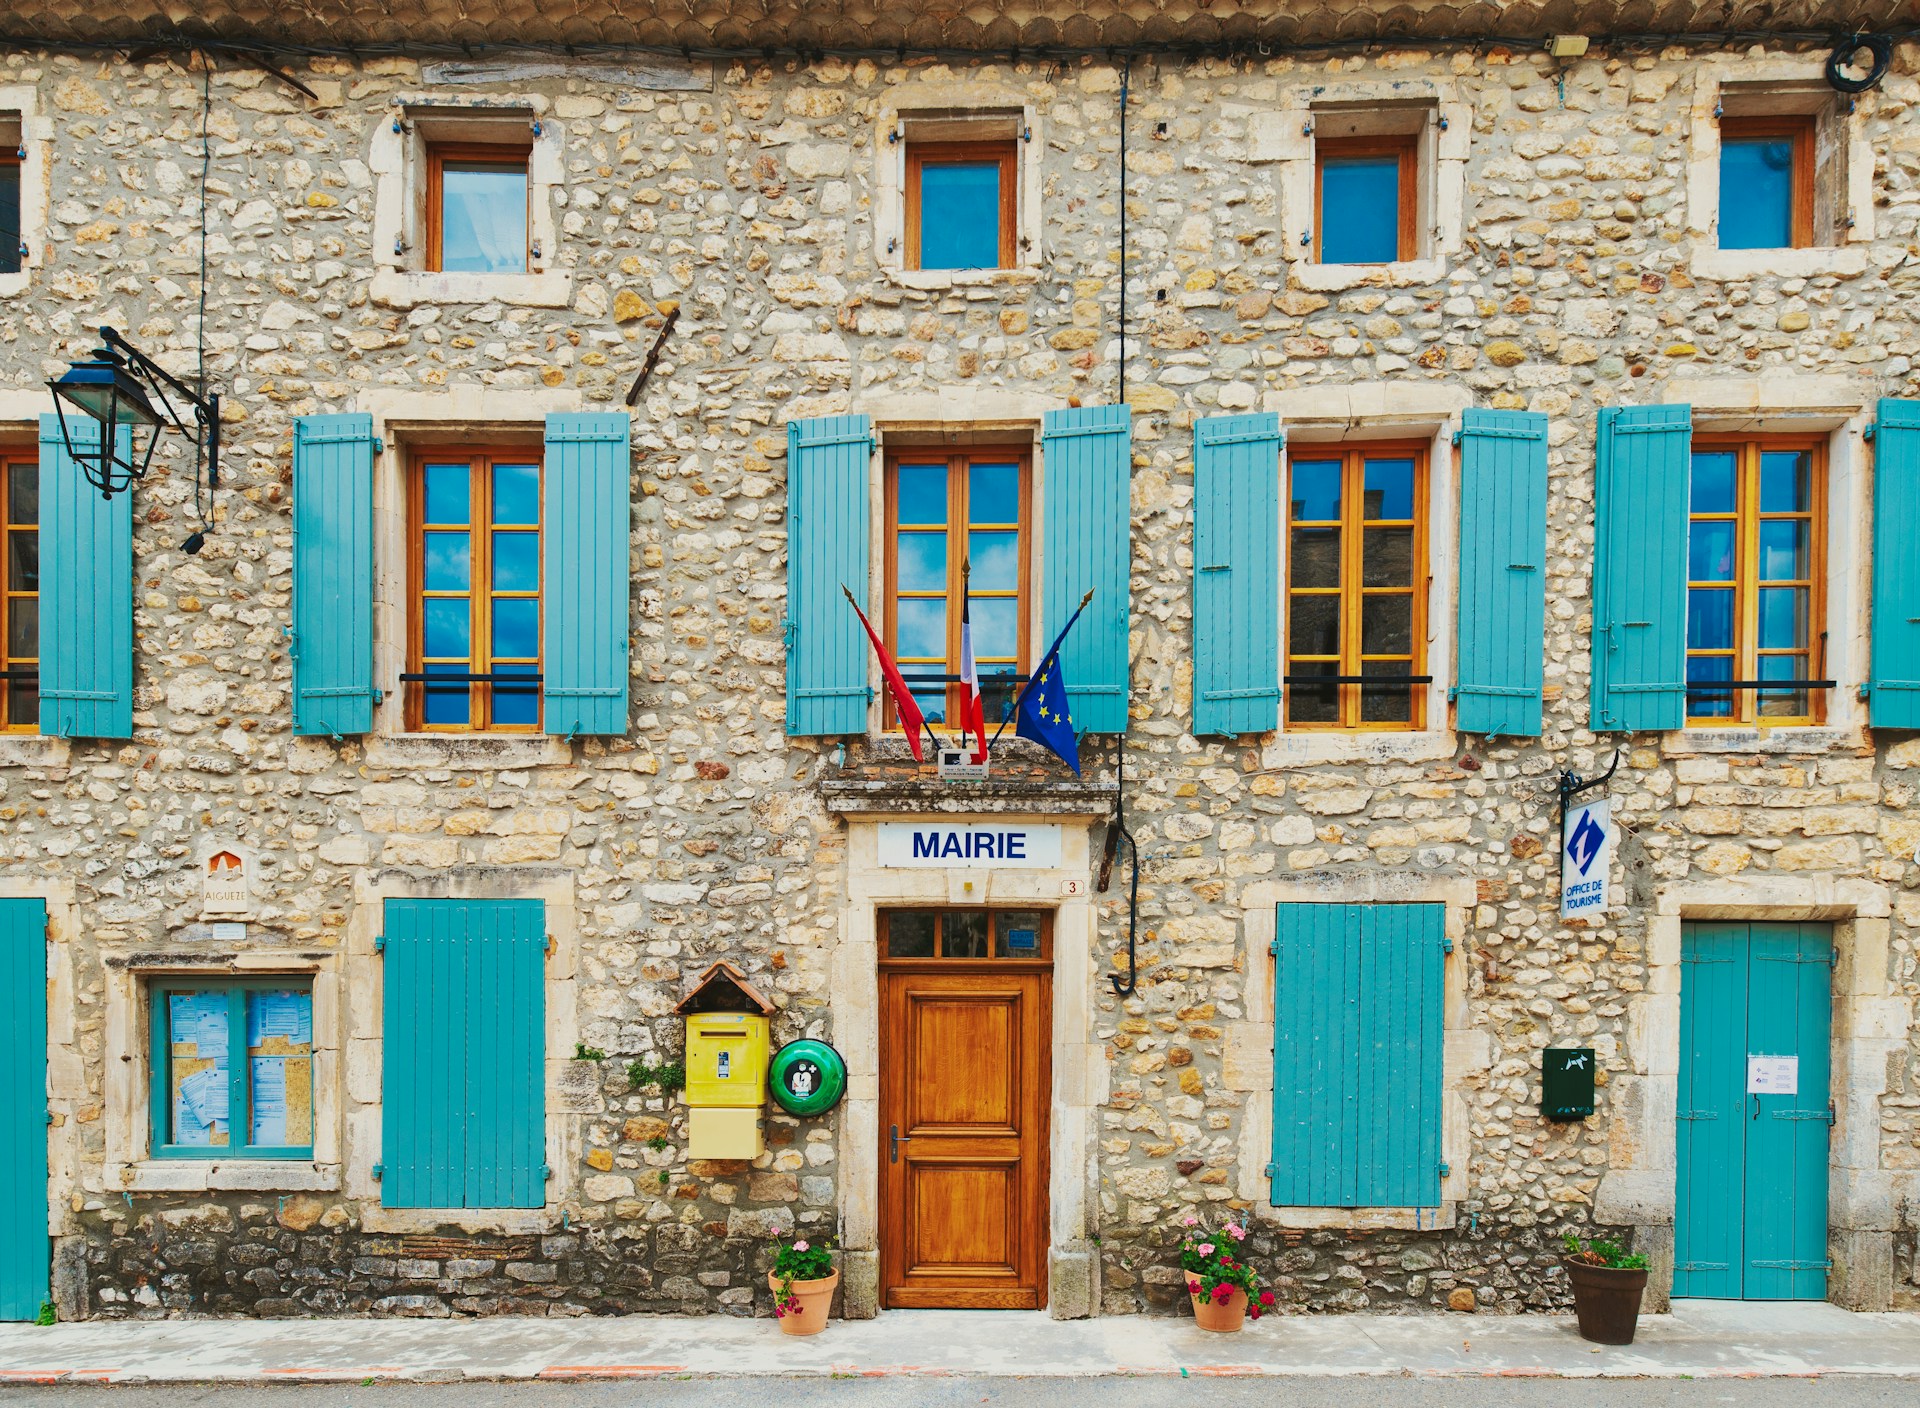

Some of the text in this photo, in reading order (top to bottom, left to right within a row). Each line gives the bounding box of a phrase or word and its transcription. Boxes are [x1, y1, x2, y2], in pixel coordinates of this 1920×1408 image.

[913, 832, 1026, 859] MAIRIE
[1069, 882, 1077, 893] 3
[1566, 880, 1602, 897] OFFICE DE
[204, 891, 246, 901] AIGUEZE
[1566, 894, 1602, 910] TOURISME
